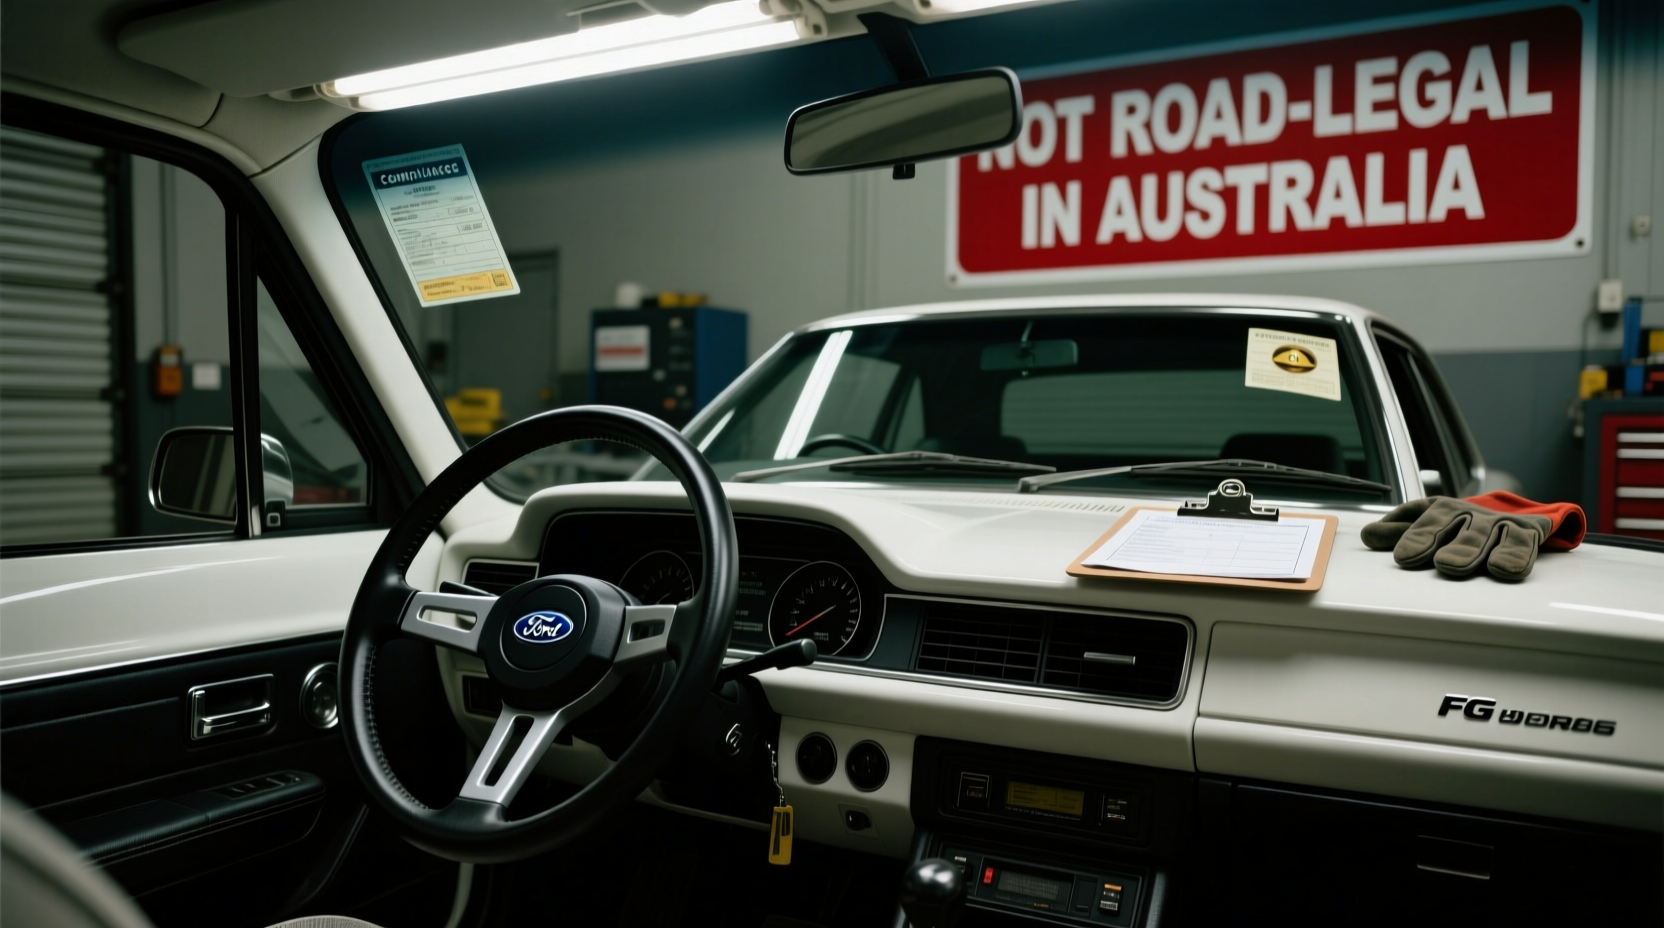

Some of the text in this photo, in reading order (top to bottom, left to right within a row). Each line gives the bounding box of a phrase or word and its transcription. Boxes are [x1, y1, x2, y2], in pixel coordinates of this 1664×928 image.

[1111, 40, 1553, 158] ROAD-LEGAL
[1022, 144, 1486, 249] IN AUSTRALIA
[523, 614, 563, 637] Ford
[1437, 693, 1497, 722] FG
